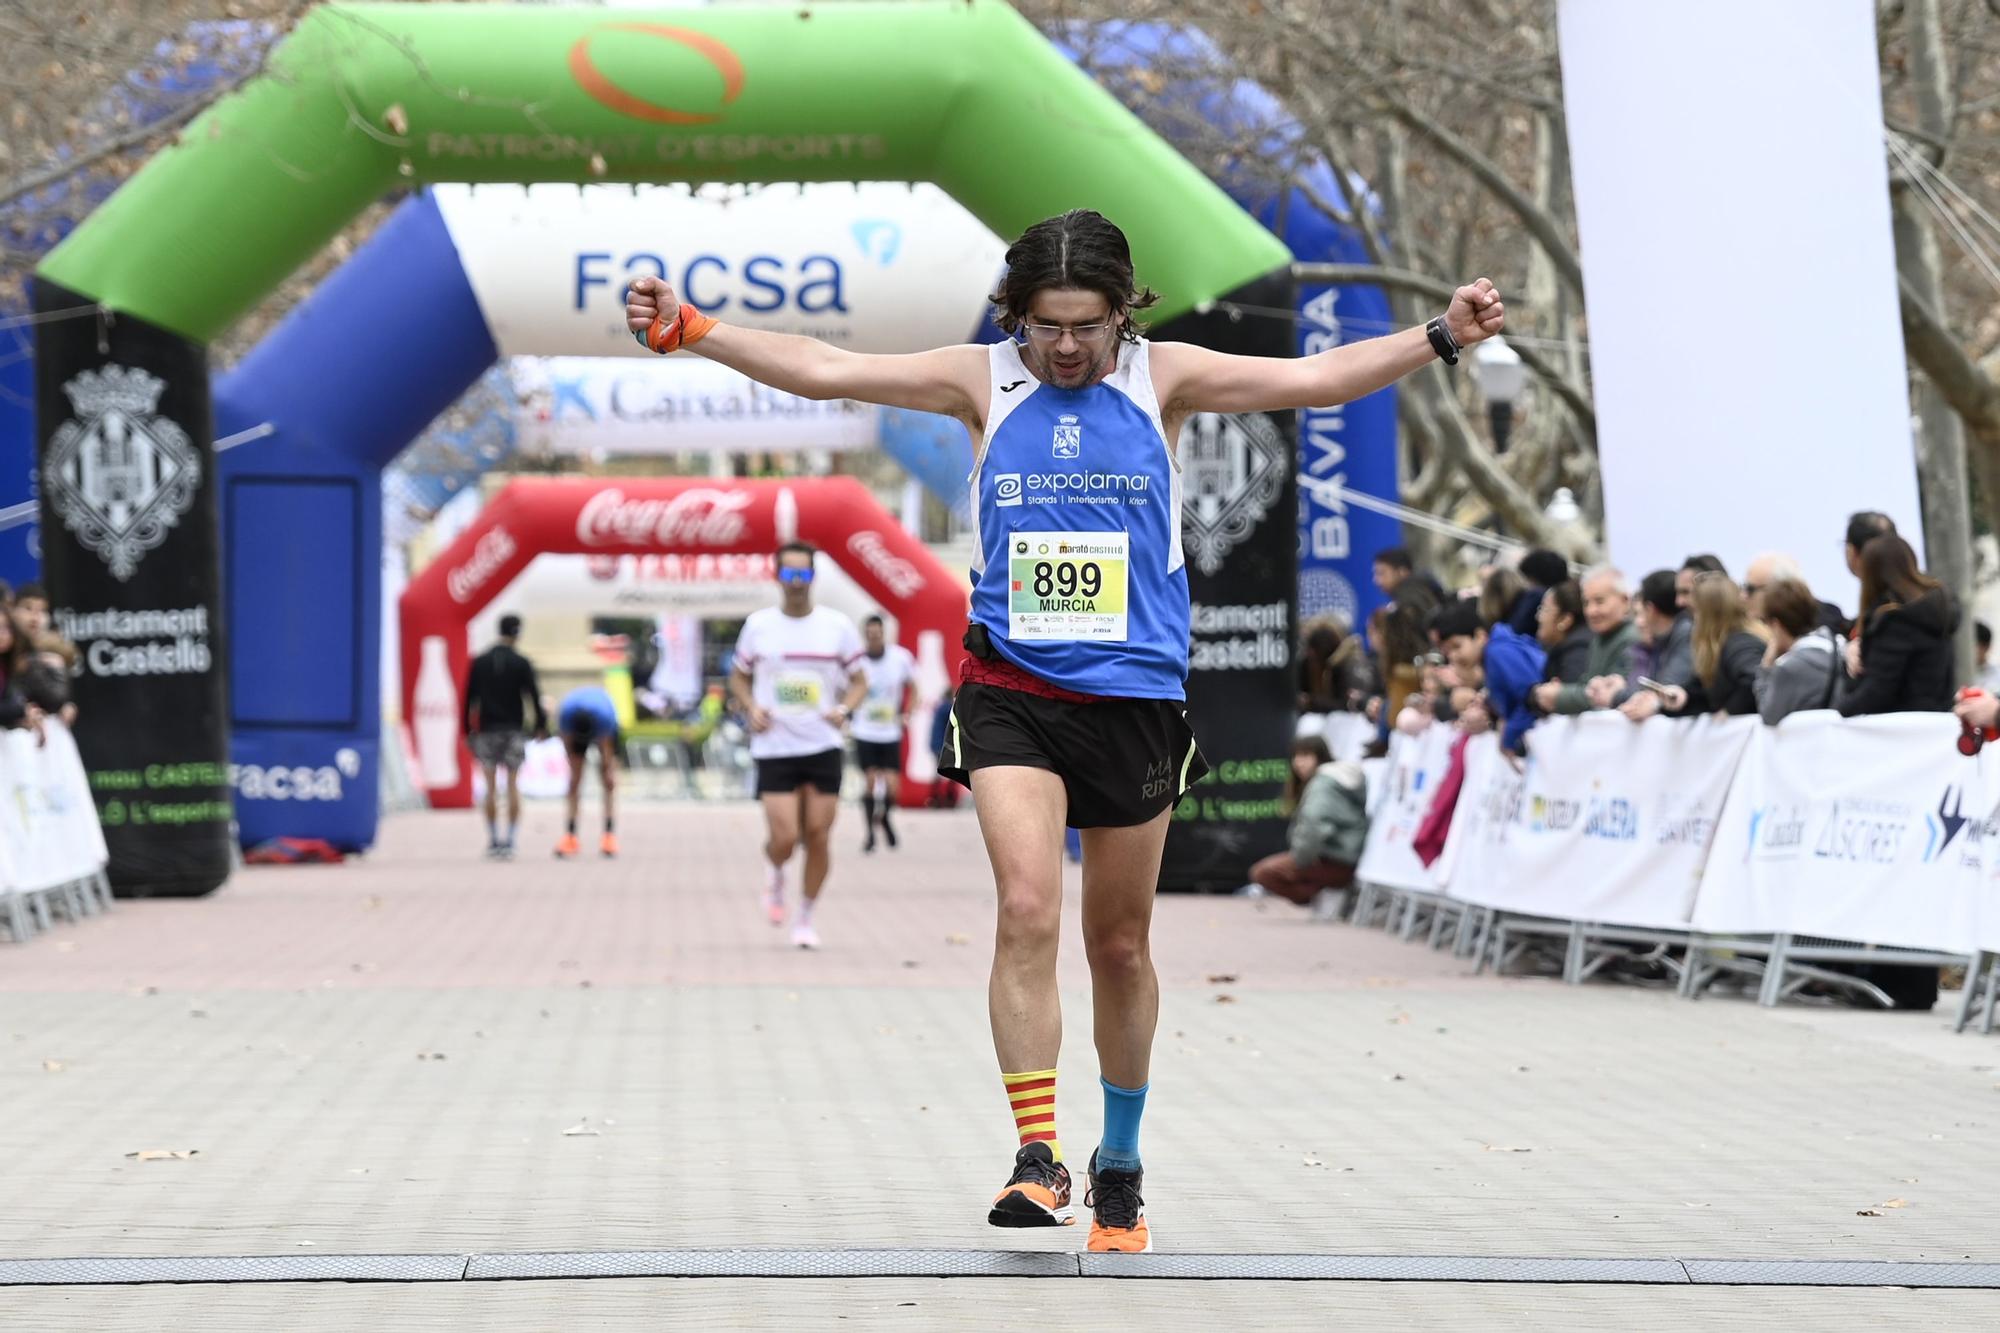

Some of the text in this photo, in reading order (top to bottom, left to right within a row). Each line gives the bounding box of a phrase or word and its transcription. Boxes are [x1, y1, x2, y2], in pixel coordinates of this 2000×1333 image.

[1304, 288, 1351, 560] BAVIRA
[1027, 470, 1150, 493] expojamar
[1027, 495, 1057, 505] Stands
[1068, 496, 1119, 505] Interiorismo
[1129, 497, 1147, 506] Krion
[1033, 562, 1102, 597] 899
[1040, 600, 1096, 611] MURCIA
